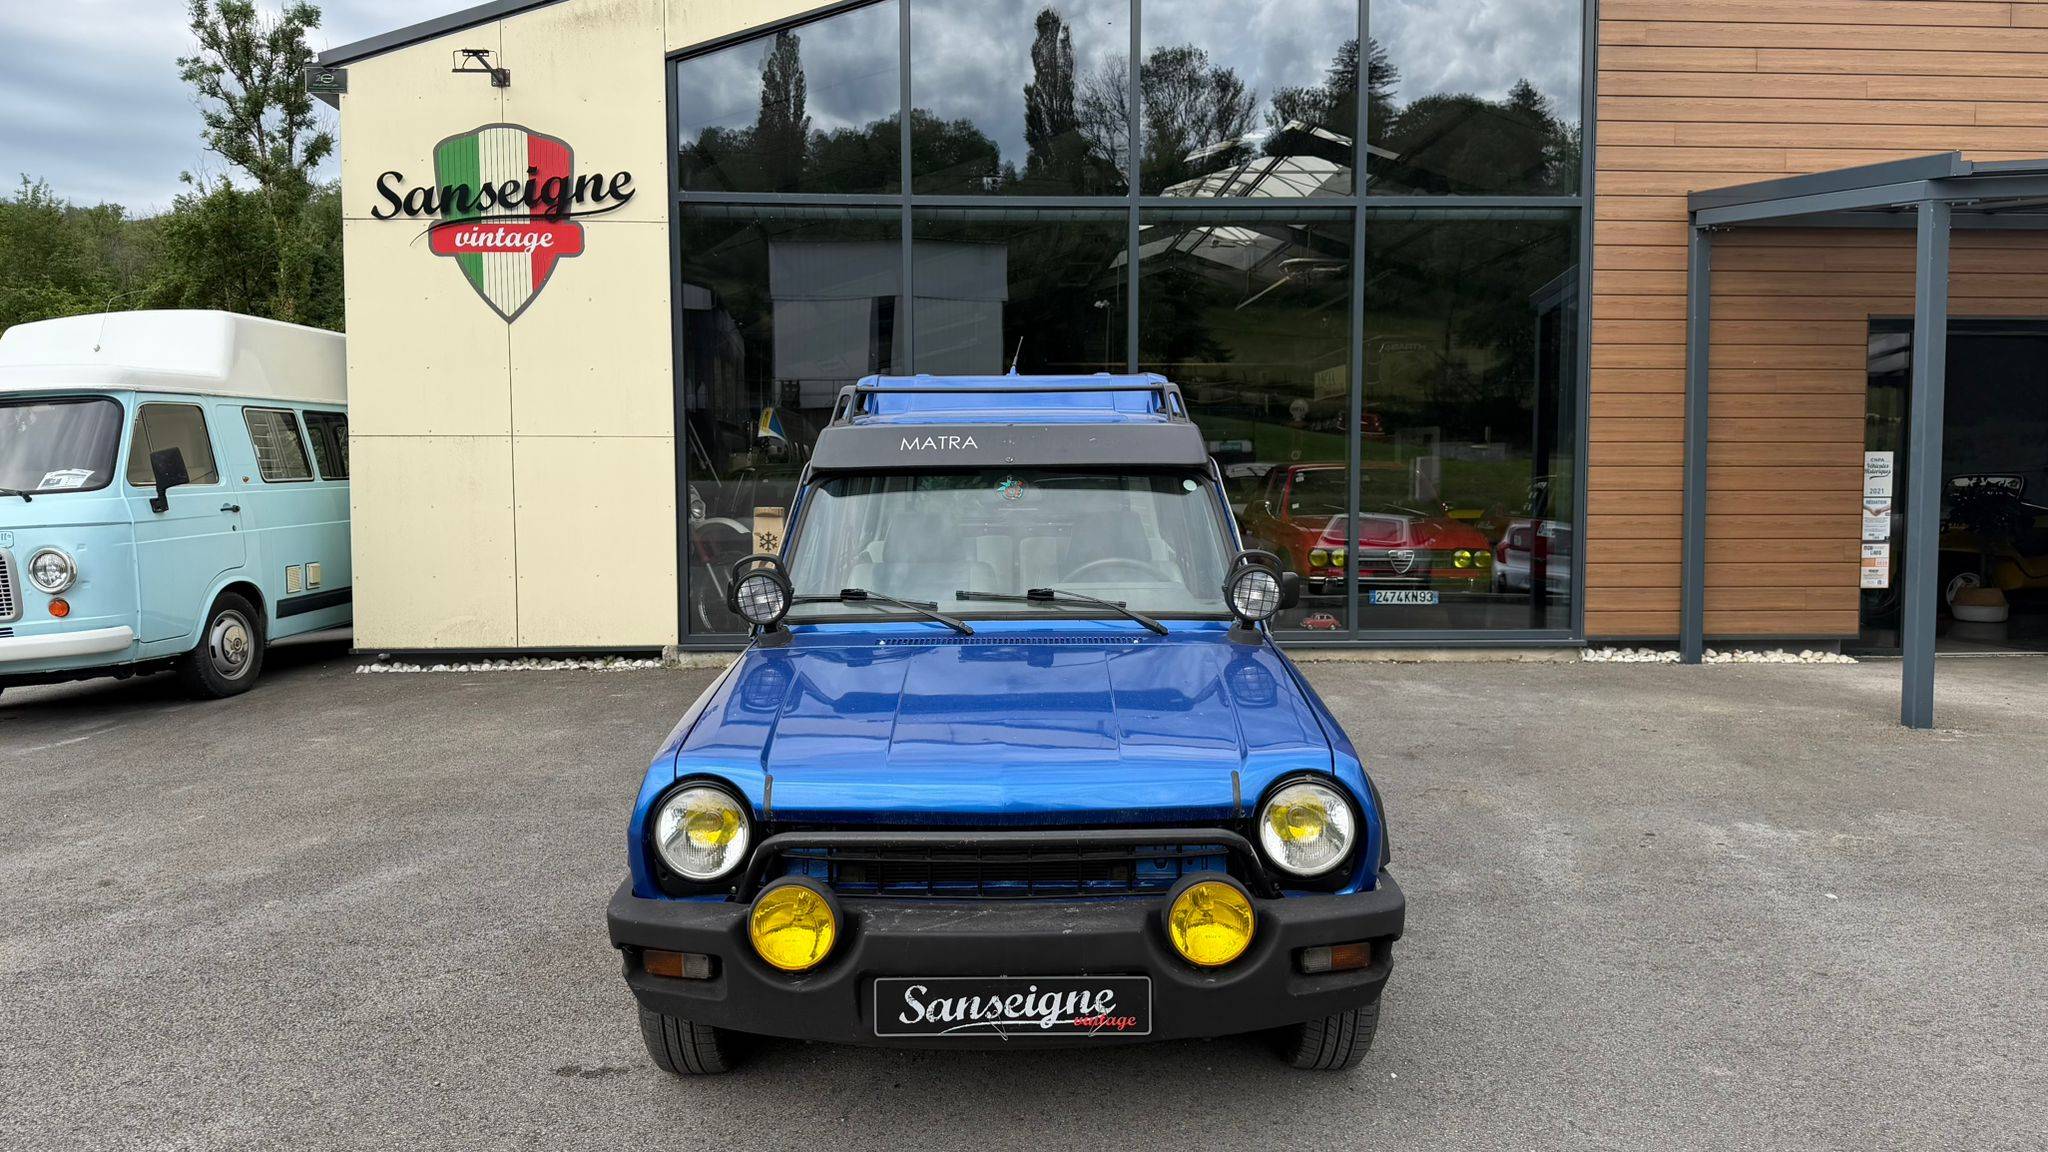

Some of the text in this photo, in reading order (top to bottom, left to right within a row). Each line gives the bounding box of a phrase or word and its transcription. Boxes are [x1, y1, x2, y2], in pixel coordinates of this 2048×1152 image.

[371, 165, 636, 221] Sanseigne
[454, 225, 554, 254] vintage
[900, 435, 978, 451] MATRA
[1376, 591, 1434, 603] 2474KN93
[899, 985, 1117, 1029] Sanseigne
[1073, 1013, 1137, 1031] vintage
